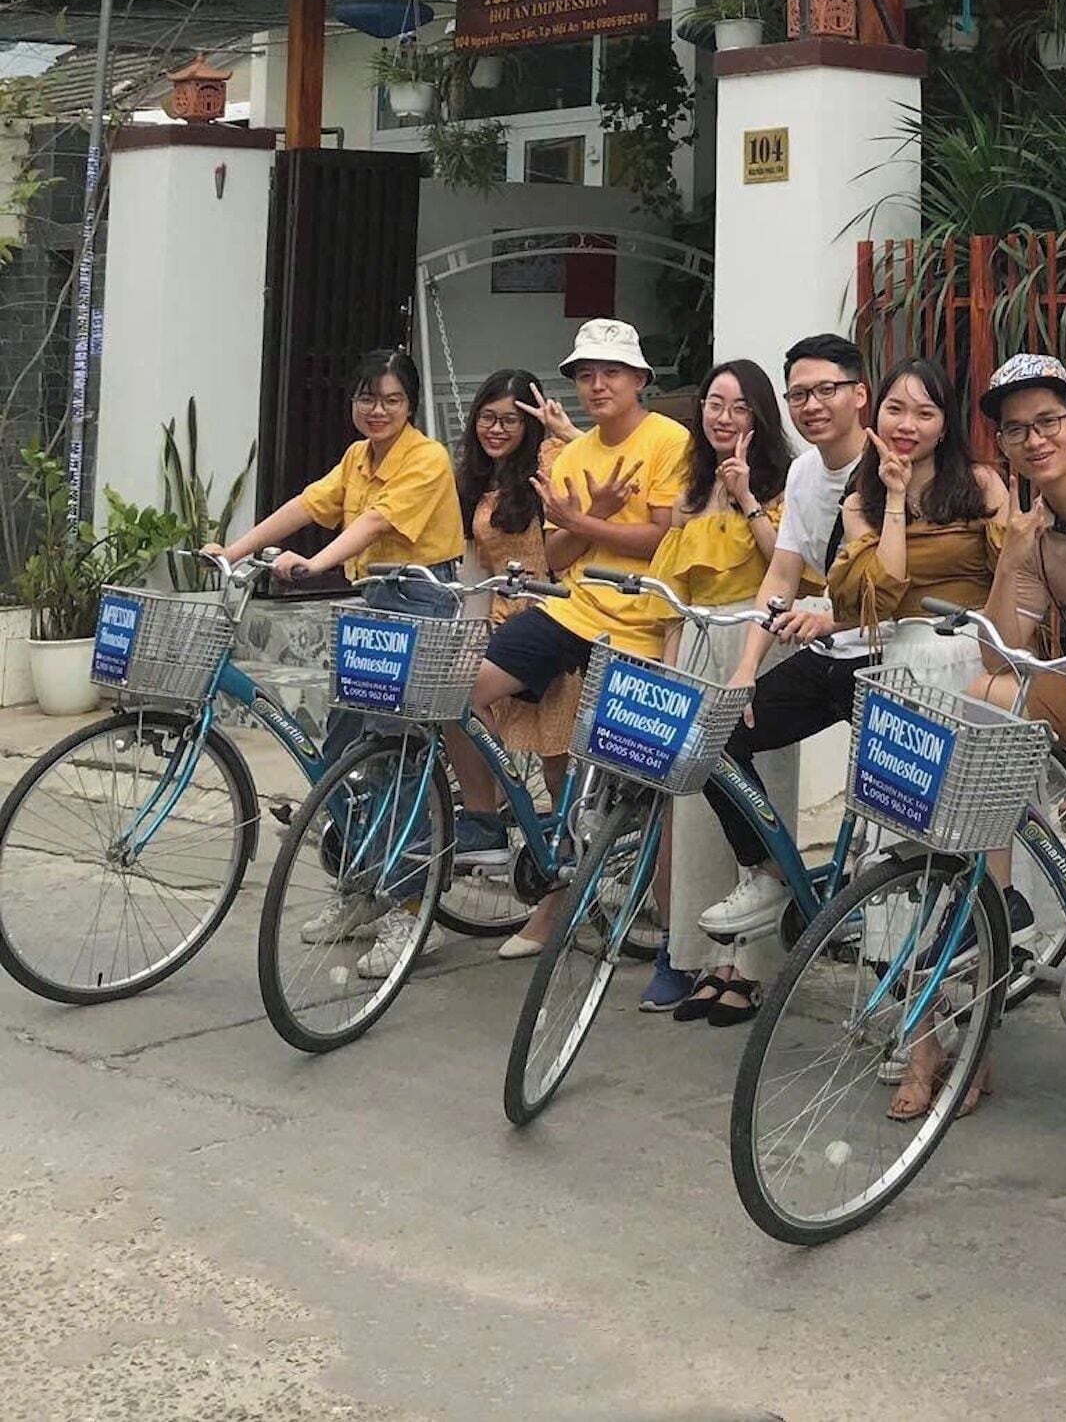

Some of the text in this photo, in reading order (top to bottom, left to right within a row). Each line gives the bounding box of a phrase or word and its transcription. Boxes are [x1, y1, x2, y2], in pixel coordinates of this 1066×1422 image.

[513, 3, 530, 20] AN
[749, 133, 784, 164] 104
[342, 624, 410, 655] IMPRESSION
[343, 649, 402, 681] Homestay
[608, 669, 691, 719] IMPRESSION
[270, 712, 305, 744] martin
[596, 727, 610, 738] 104
[606, 697, 677, 746] Homestay
[868, 704, 945, 765] IMPRESSION
[481, 733, 510, 766] martin
[606, 741, 662, 769] 0905 962 041
[867, 737, 933, 795] Homestay
[728, 771, 766, 808] martin
[869, 788, 922, 823] 0905 962 041
